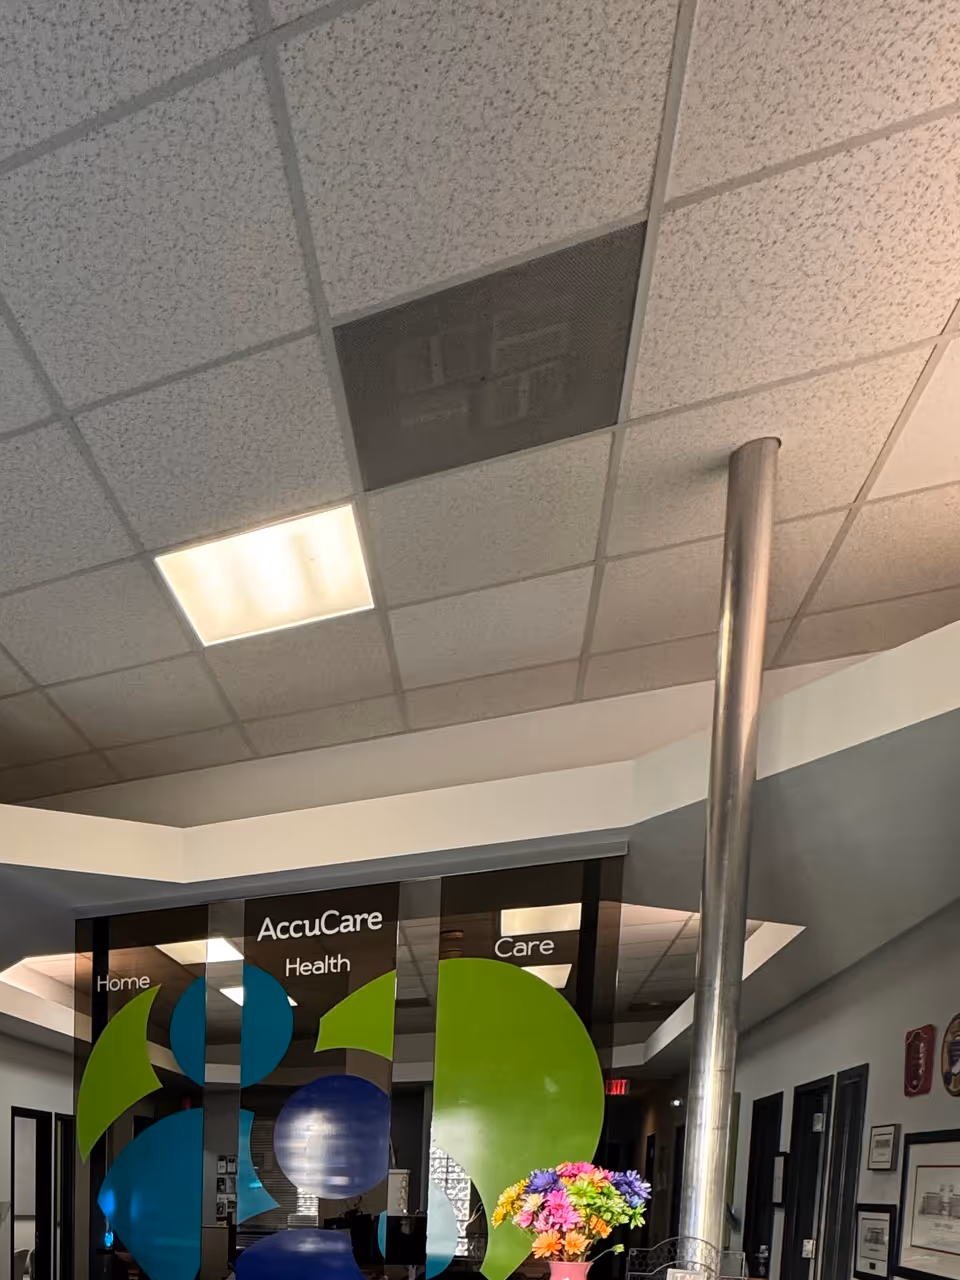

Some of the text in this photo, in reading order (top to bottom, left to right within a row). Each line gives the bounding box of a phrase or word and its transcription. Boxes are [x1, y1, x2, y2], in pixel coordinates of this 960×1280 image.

[257, 909, 383, 942] AccuCare
[494, 935, 555, 959] Care
[285, 953, 351, 977] Health
[97, 974, 150, 993] Home
